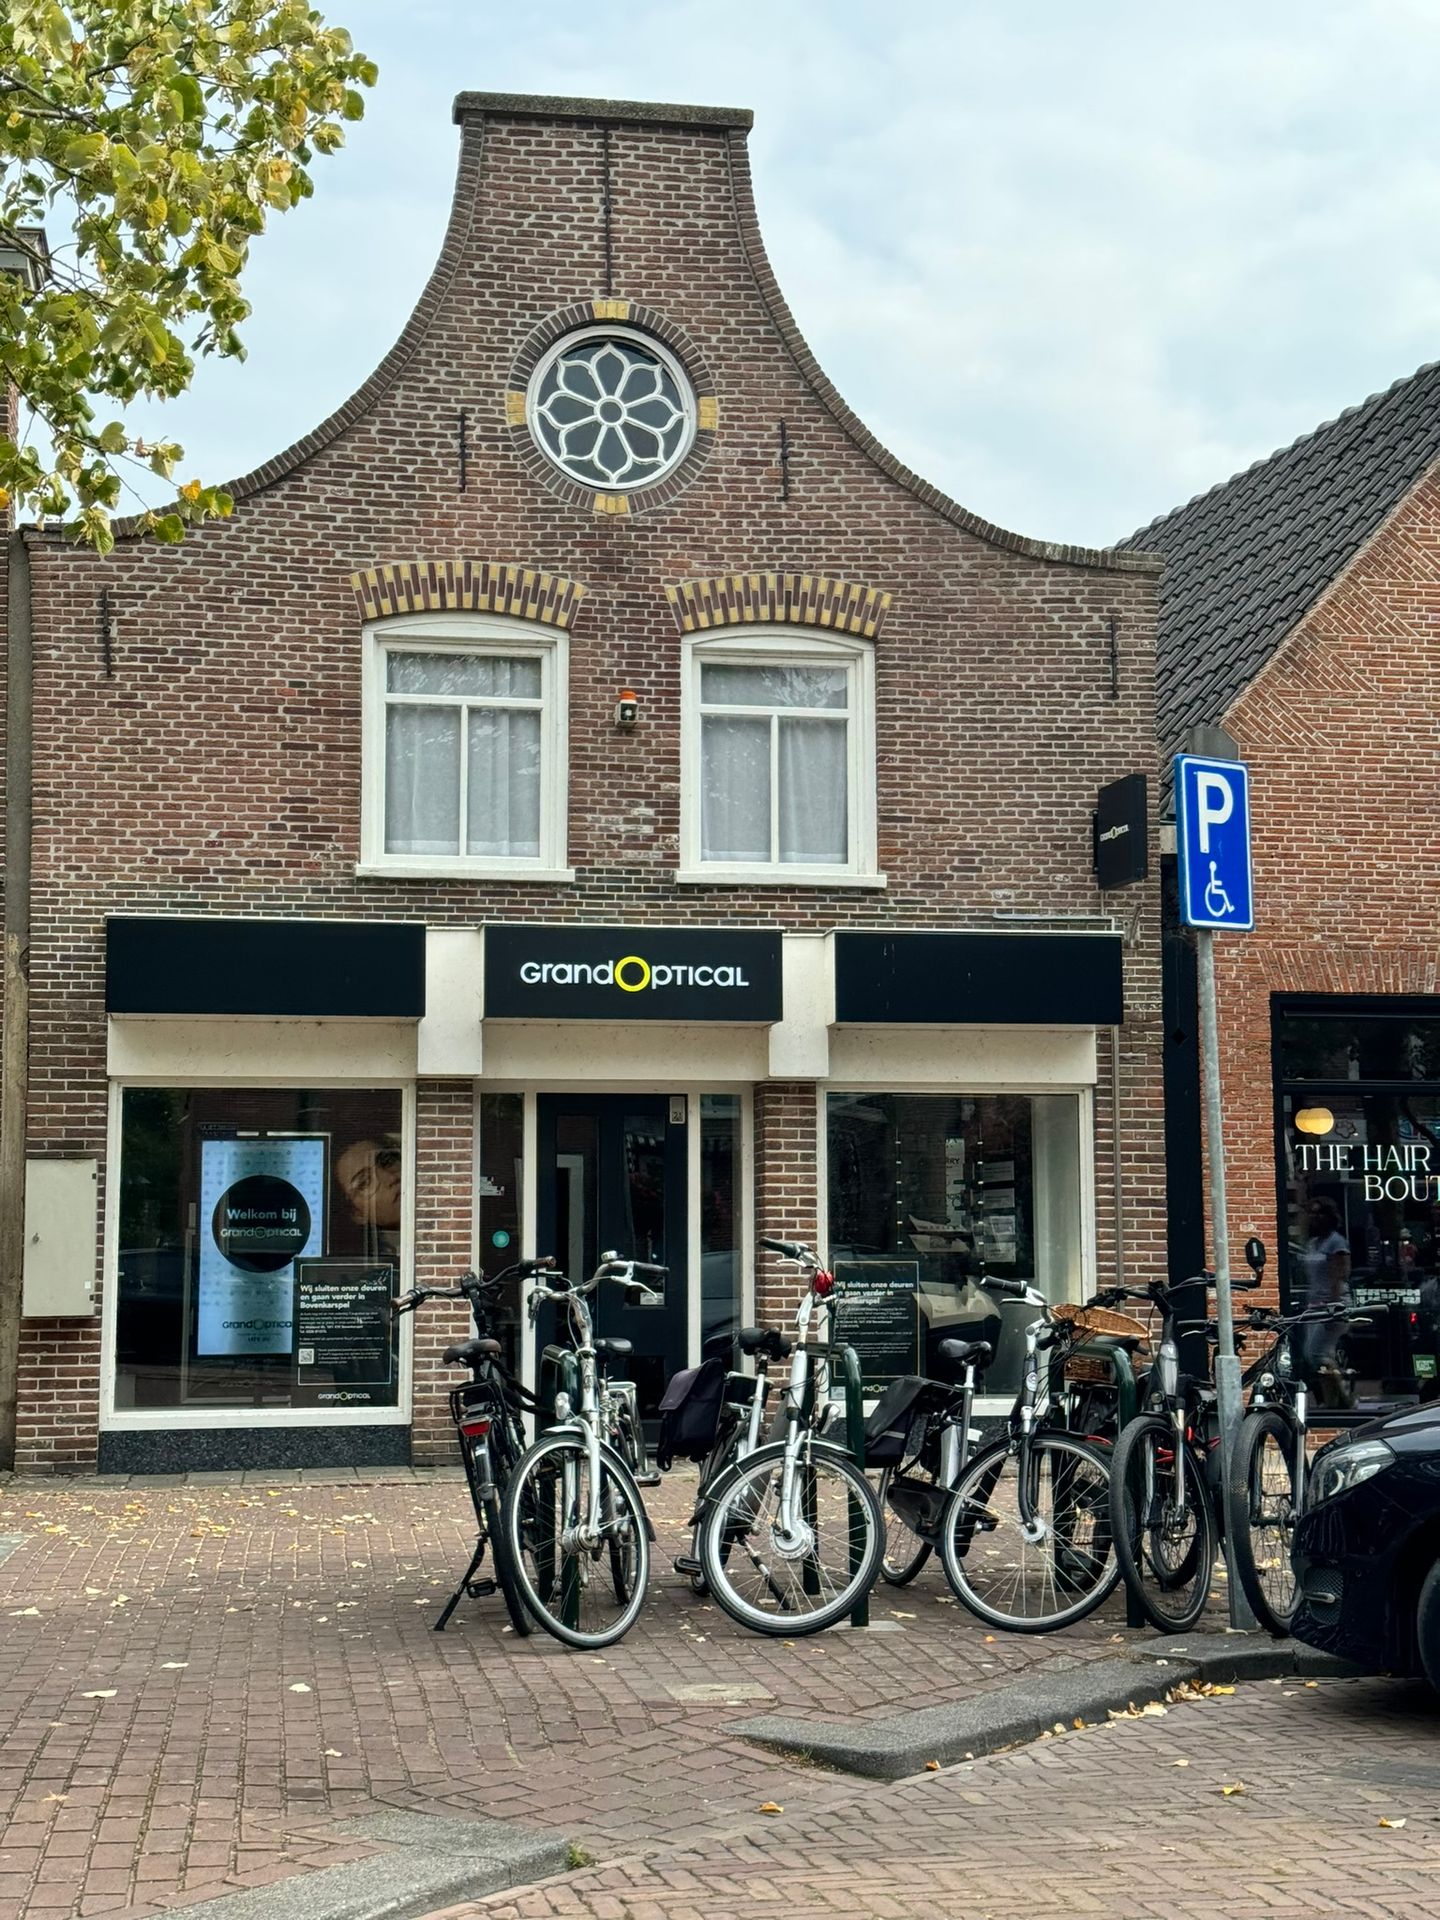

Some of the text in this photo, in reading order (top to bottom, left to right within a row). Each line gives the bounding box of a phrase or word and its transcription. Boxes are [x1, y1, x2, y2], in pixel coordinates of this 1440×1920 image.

[1195, 770, 1234, 854] P
[1295, 1144, 1431, 1171] THE HAIR
[226, 1208, 297, 1222] Welkom bij
[300, 1284, 313, 1294] Wij
[314, 1284, 340, 1292] sluiten
[360, 1284, 387, 1292] deuren
[889, 1280, 914, 1288] deuren
[311, 1294, 330, 1302] gaan
[331, 1292, 357, 1300] verder
[357, 1292, 366, 1300] in
[844, 1290, 861, 1298] gaan
[300, 1301, 350, 1310] Bovenkarspel
